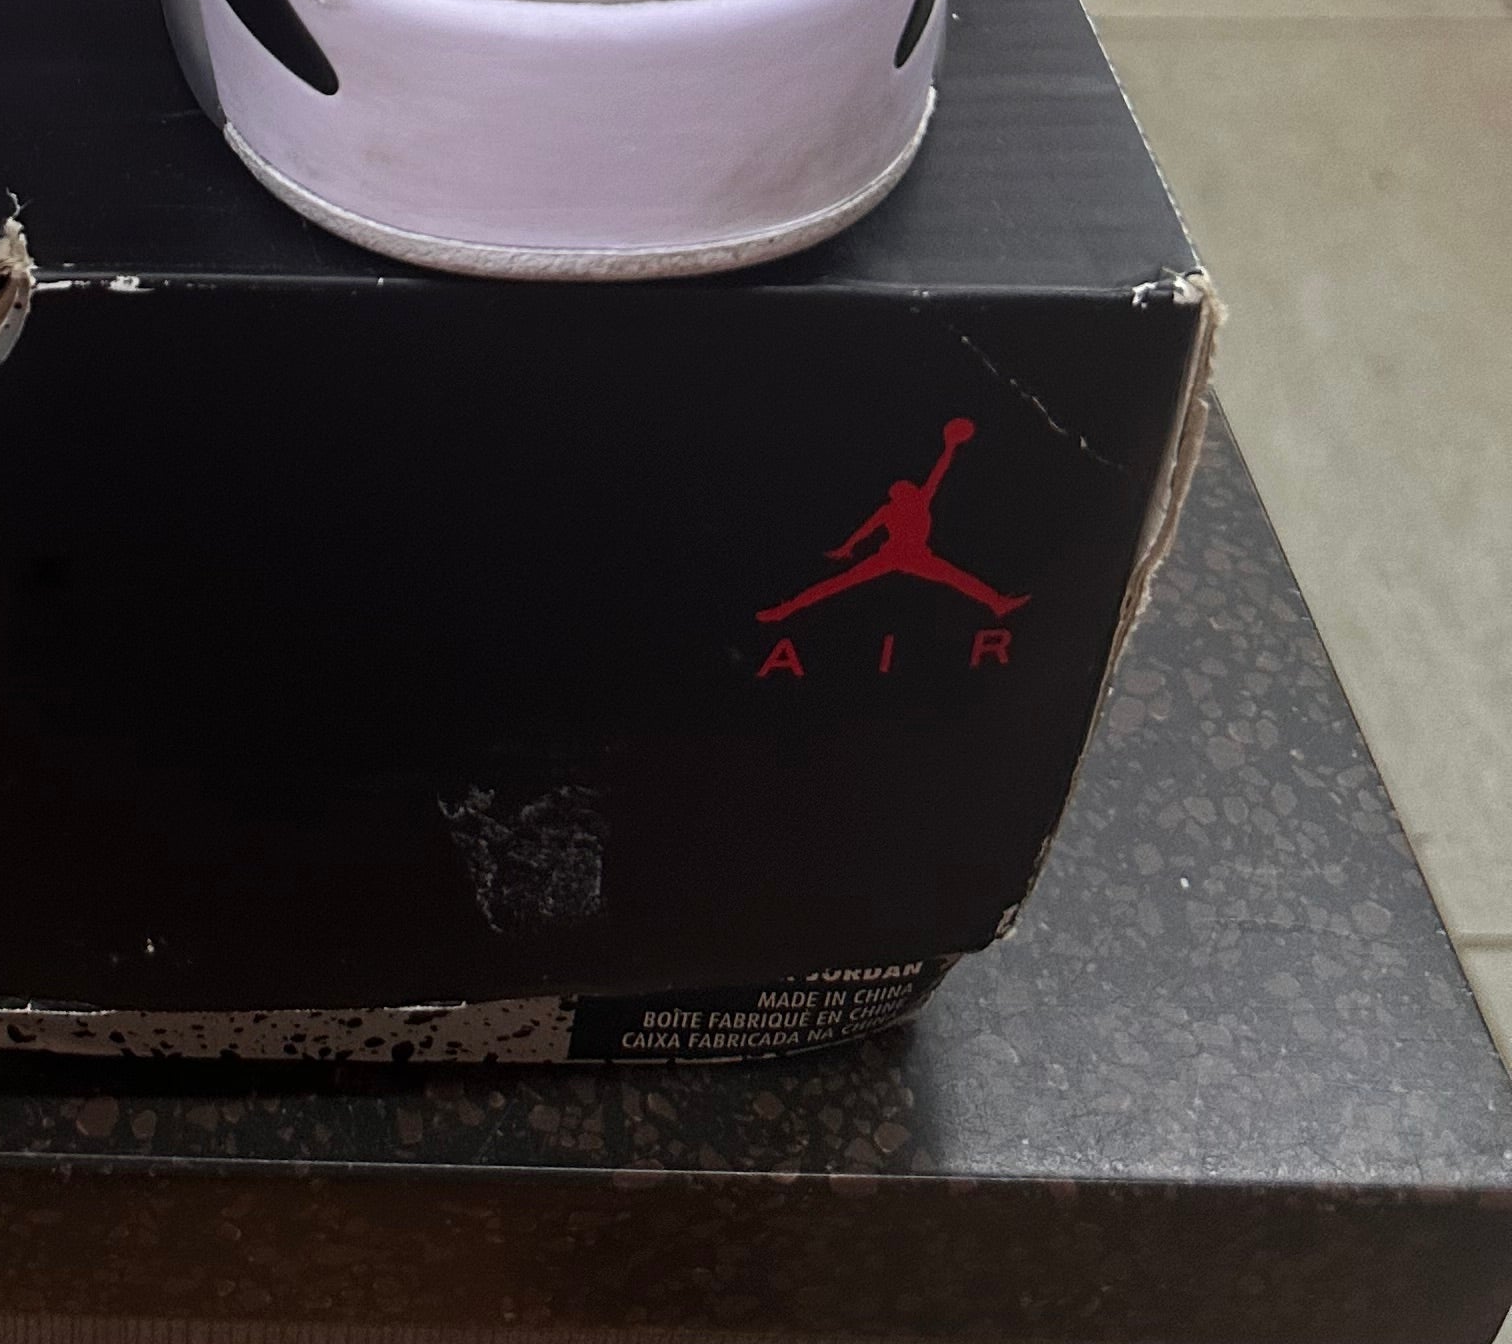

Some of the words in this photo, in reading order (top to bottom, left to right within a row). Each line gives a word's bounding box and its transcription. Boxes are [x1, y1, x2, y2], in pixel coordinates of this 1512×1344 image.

[756, 628, 1013, 678] AIR
[757, 991, 819, 1009] MADE
[824, 990, 848, 1008] IN
[853, 982, 914, 1005] CHINA
[642, 1007, 703, 1029] BOÎTE
[816, 1009, 844, 1026] EN
[621, 1031, 681, 1048] CAIXA
[687, 1030, 800, 1049] FABRICADA
[807, 1027, 834, 1042] NA
